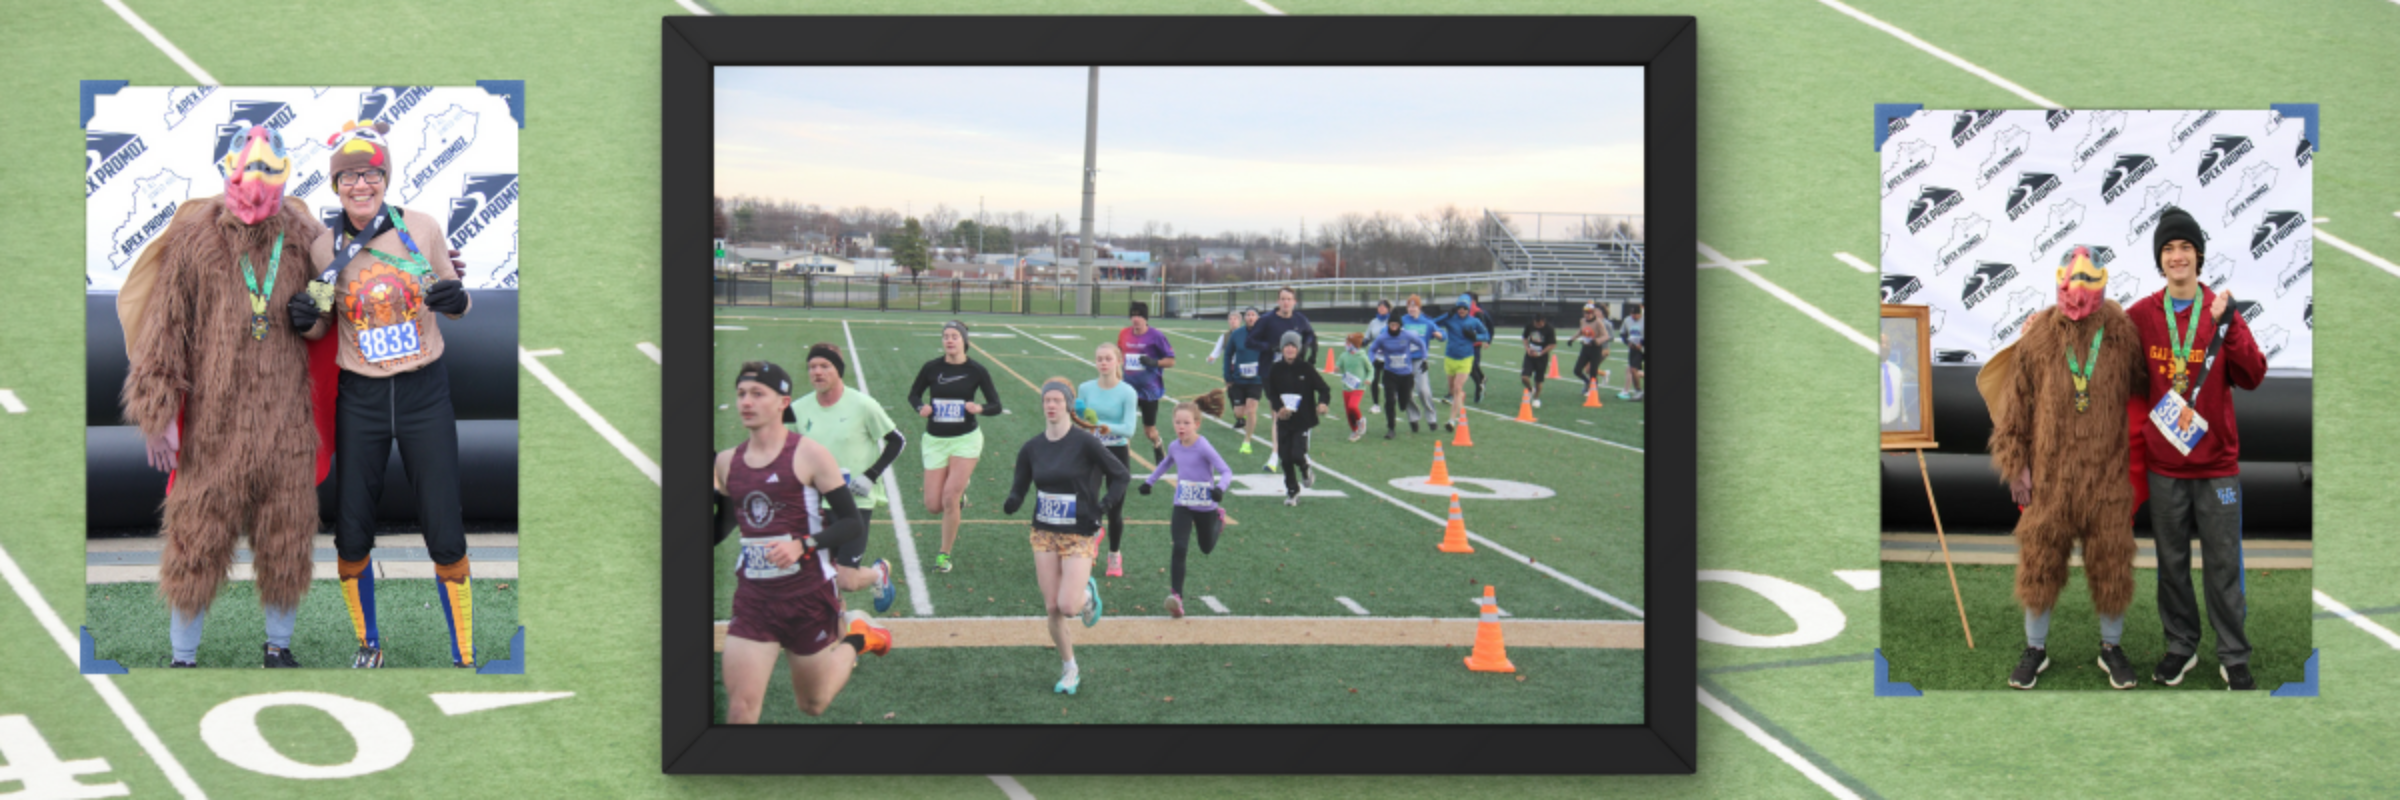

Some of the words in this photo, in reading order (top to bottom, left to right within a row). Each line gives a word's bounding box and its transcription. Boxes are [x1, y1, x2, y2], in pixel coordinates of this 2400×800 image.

[94, 135, 148, 185] PROMOZ
[412, 164, 434, 189] APEX
[432, 135, 468, 168] PROMOZ
[1954, 129, 1977, 149] APEX
[2200, 166, 2223, 188] APEX
[2219, 138, 2255, 170] PROMOZ
[2007, 200, 2031, 222] APEX
[2028, 174, 2062, 206] PROMOZ
[2103, 184, 2127, 206] APEX
[2123, 156, 2158, 189] PROMOZ
[121, 230, 145, 255] APEX
[141, 201, 177, 236] PROMOZ
[450, 214, 485, 252] APEX
[1909, 213, 1932, 236] APEX
[1930, 191, 1965, 217] PROMOZ
[2252, 238, 2274, 260] APEX
[2271, 212, 2306, 245] PROMOZ
[1963, 288, 1987, 311] APEX
[1984, 265, 2019, 296] PROMOZ
[360, 322, 417, 358] 3833
[2158, 397, 2197, 443] 398
